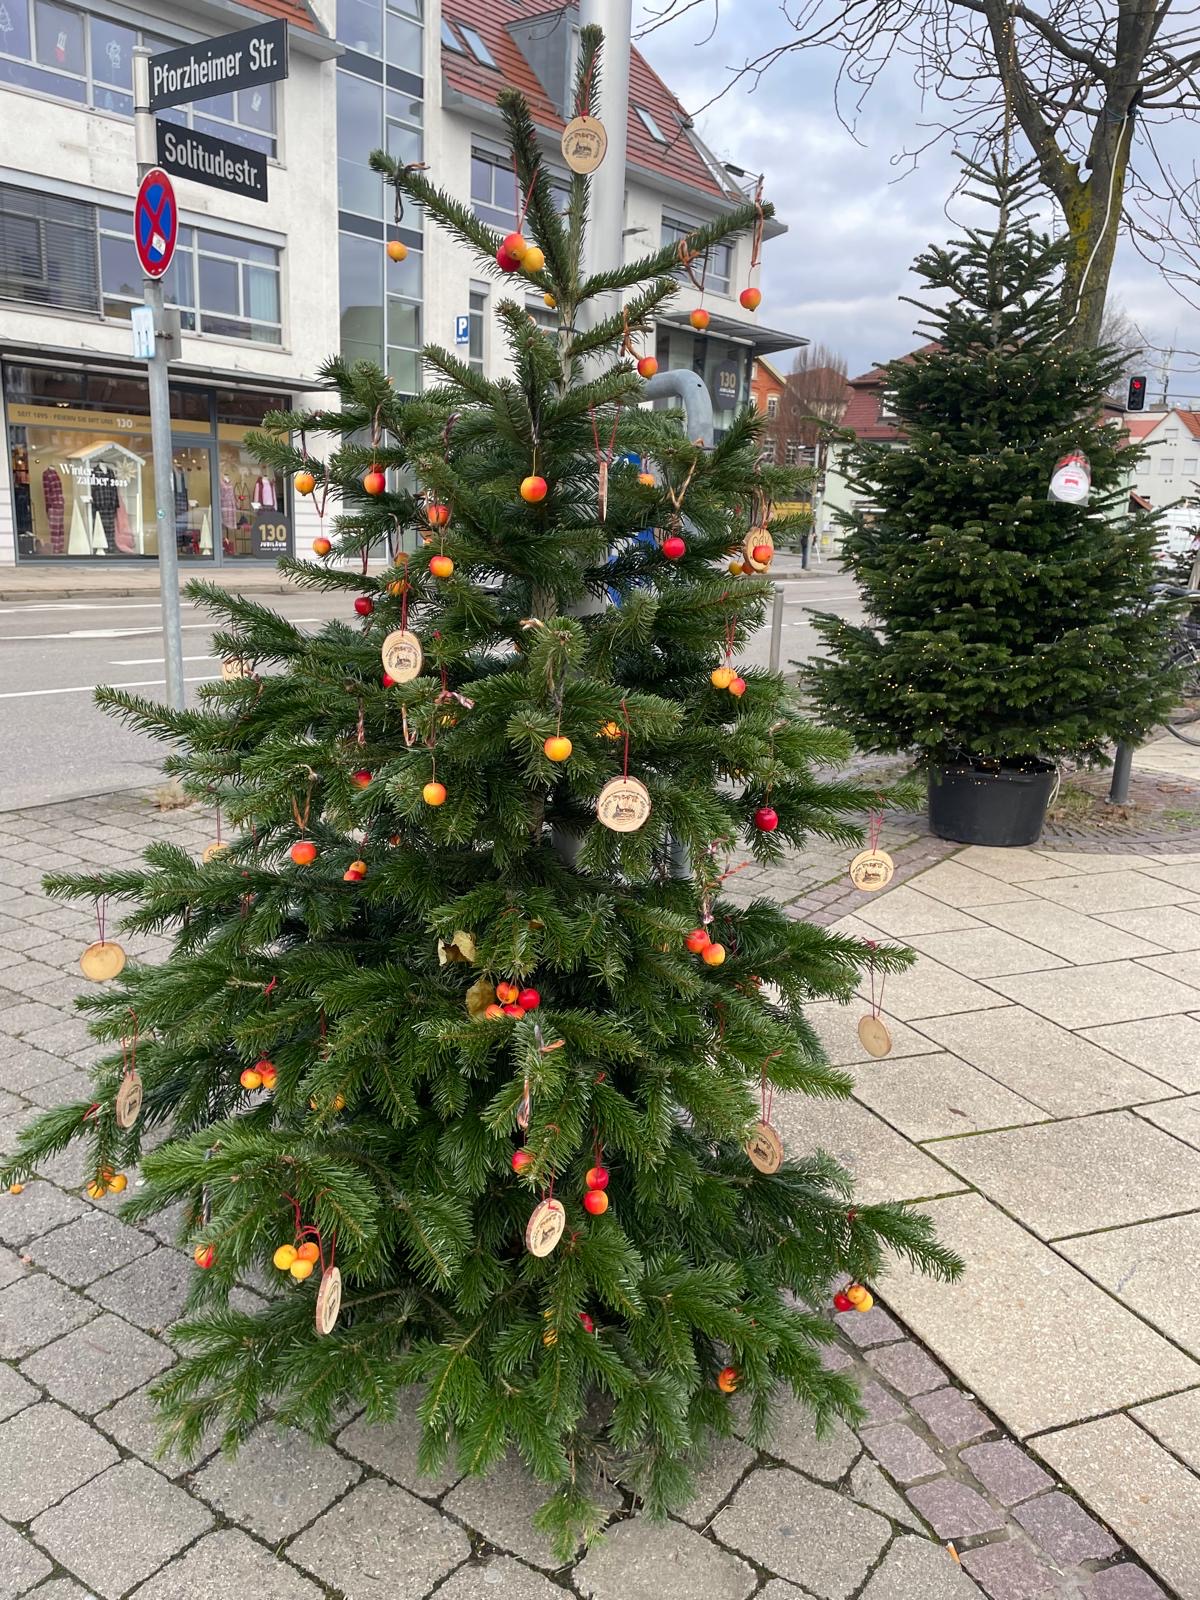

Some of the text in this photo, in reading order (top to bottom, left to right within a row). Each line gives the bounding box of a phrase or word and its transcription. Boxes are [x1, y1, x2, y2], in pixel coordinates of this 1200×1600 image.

[153, 38, 278, 96] Pforzheimer Str.
[164, 132, 261, 189] Solitudestr.
[458, 317, 468, 336] P
[719, 371, 737, 388] 130
[116, 418, 133, 429] 130
[60, 463, 94, 476] Winter
[76, 473, 109, 487] zauber
[258, 524, 287, 542] 130
